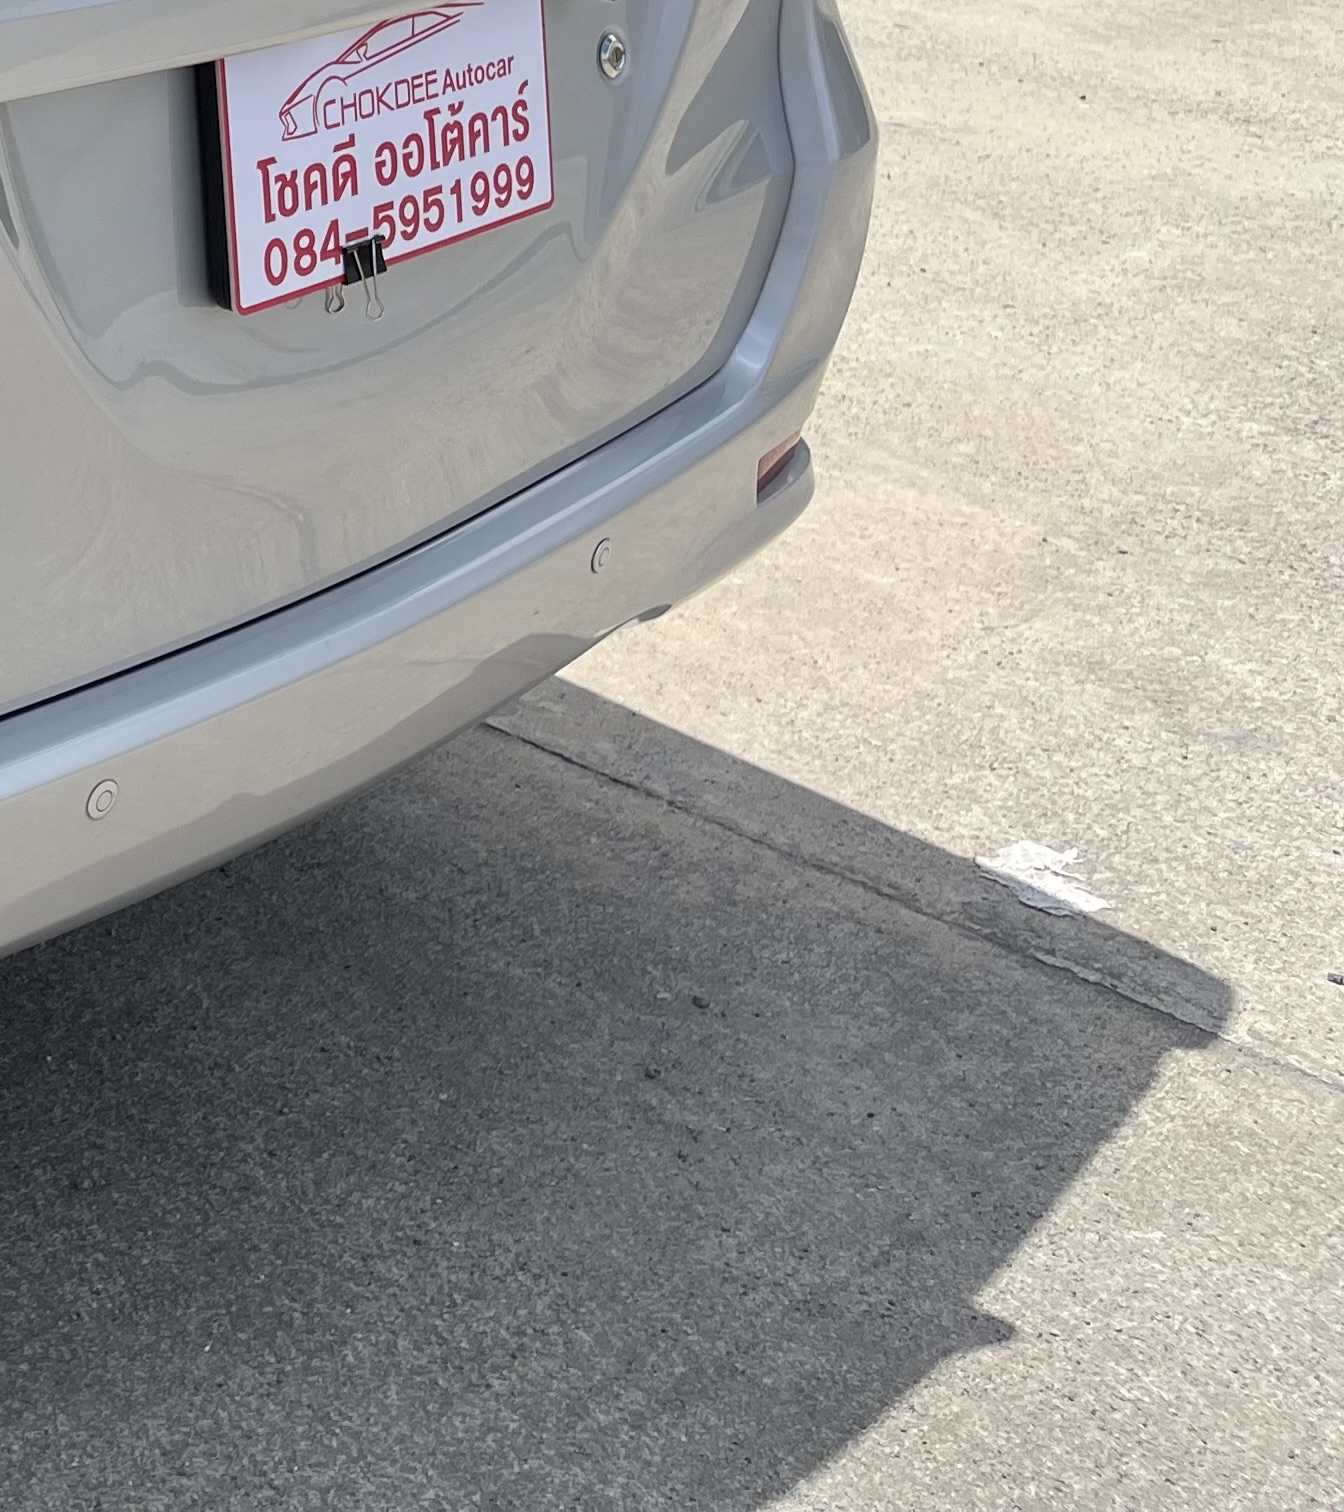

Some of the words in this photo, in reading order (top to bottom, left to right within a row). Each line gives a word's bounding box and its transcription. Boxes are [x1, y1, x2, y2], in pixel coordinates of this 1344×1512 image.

[257, 133, 359, 224] โชคดี
[375, 79, 530, 187] ออโต้คาร์
[323, 70, 438, 130] CHOKDEE
[441, 55, 515, 95] Autocar
[263, 155, 535, 286] 084-5951999
